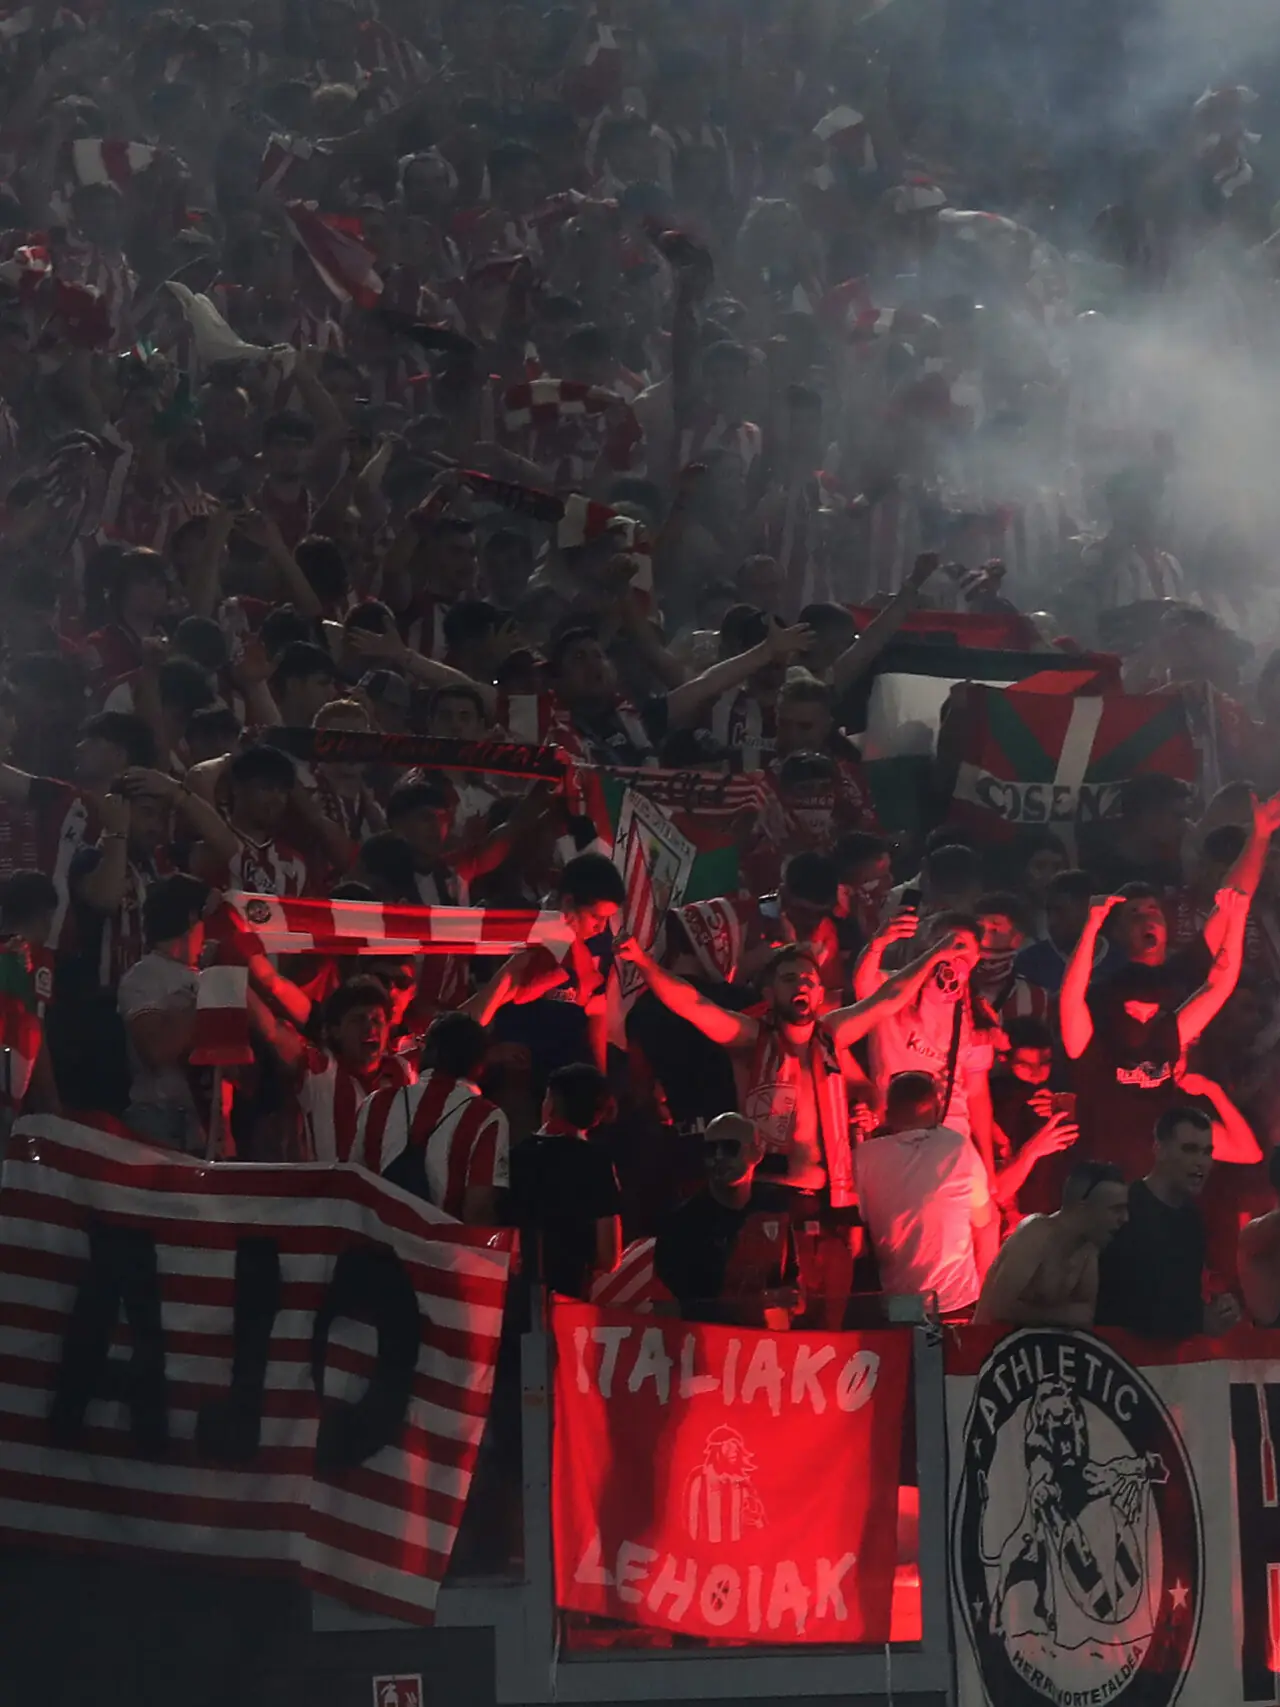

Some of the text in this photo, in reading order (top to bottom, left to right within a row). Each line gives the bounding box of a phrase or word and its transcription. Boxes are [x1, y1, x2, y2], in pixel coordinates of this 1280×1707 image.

[573, 1325, 881, 1418] ITALIAKO
[979, 1344, 1140, 1435] ATHLETIC
[573, 1526, 857, 1637] LEHOIAK
